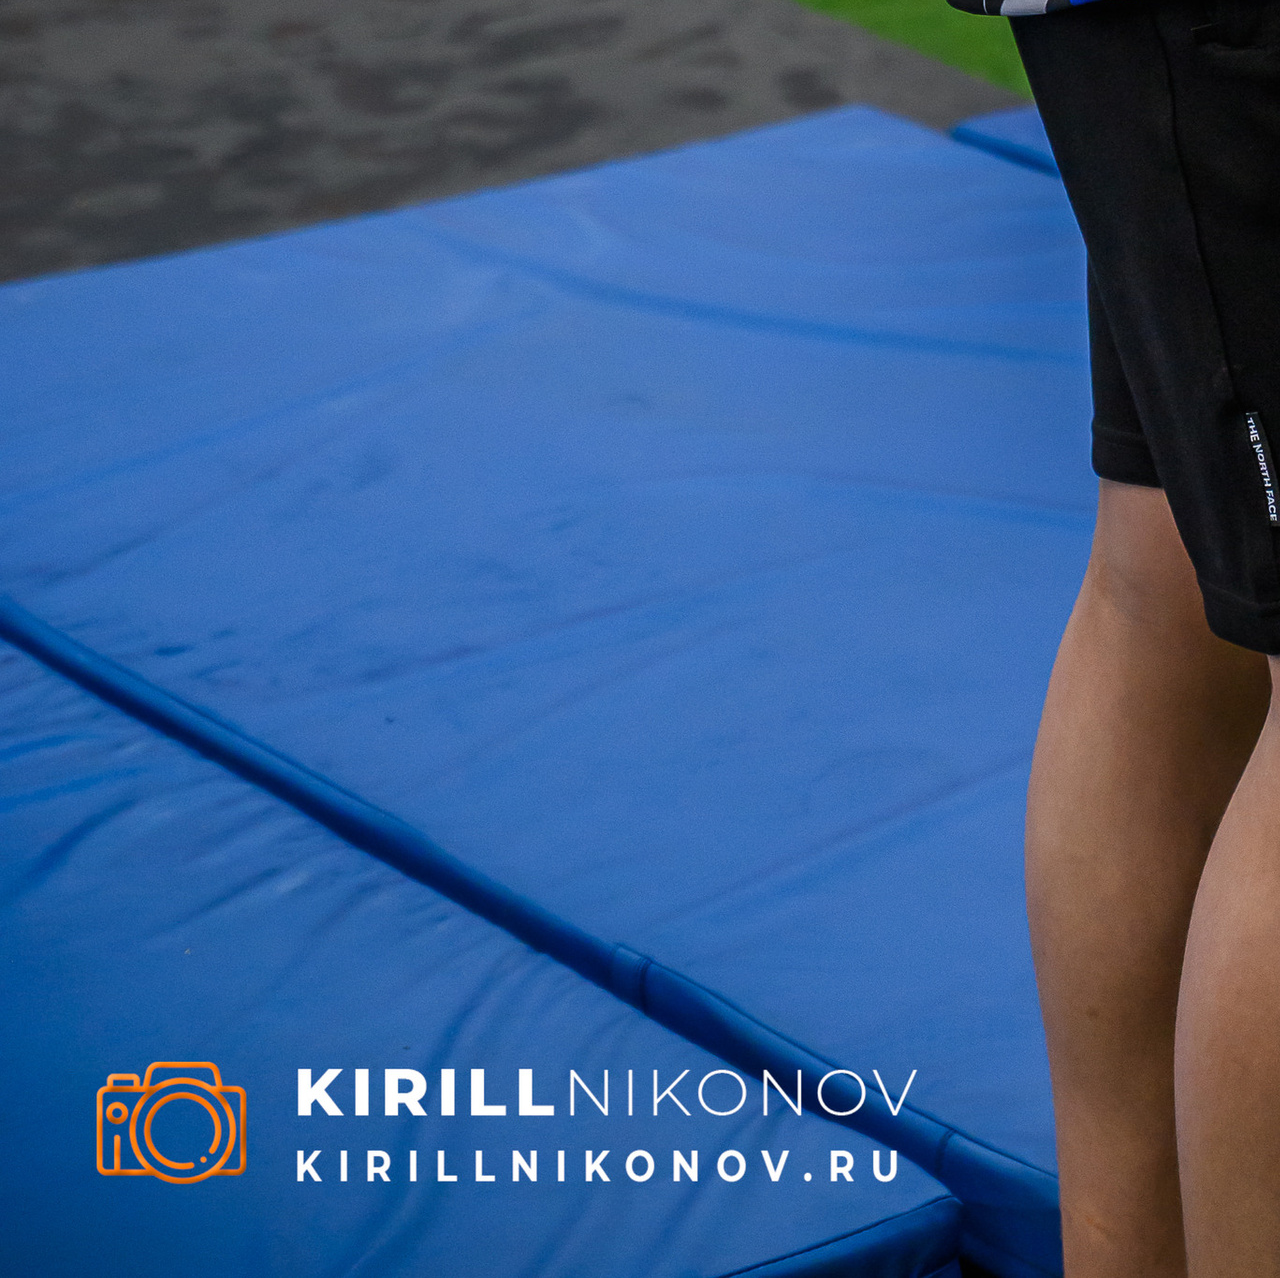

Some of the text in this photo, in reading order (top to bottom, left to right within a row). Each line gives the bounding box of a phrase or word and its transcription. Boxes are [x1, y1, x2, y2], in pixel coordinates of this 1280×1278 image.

[1247, 416, 1278, 522] THE NORTH FACE
